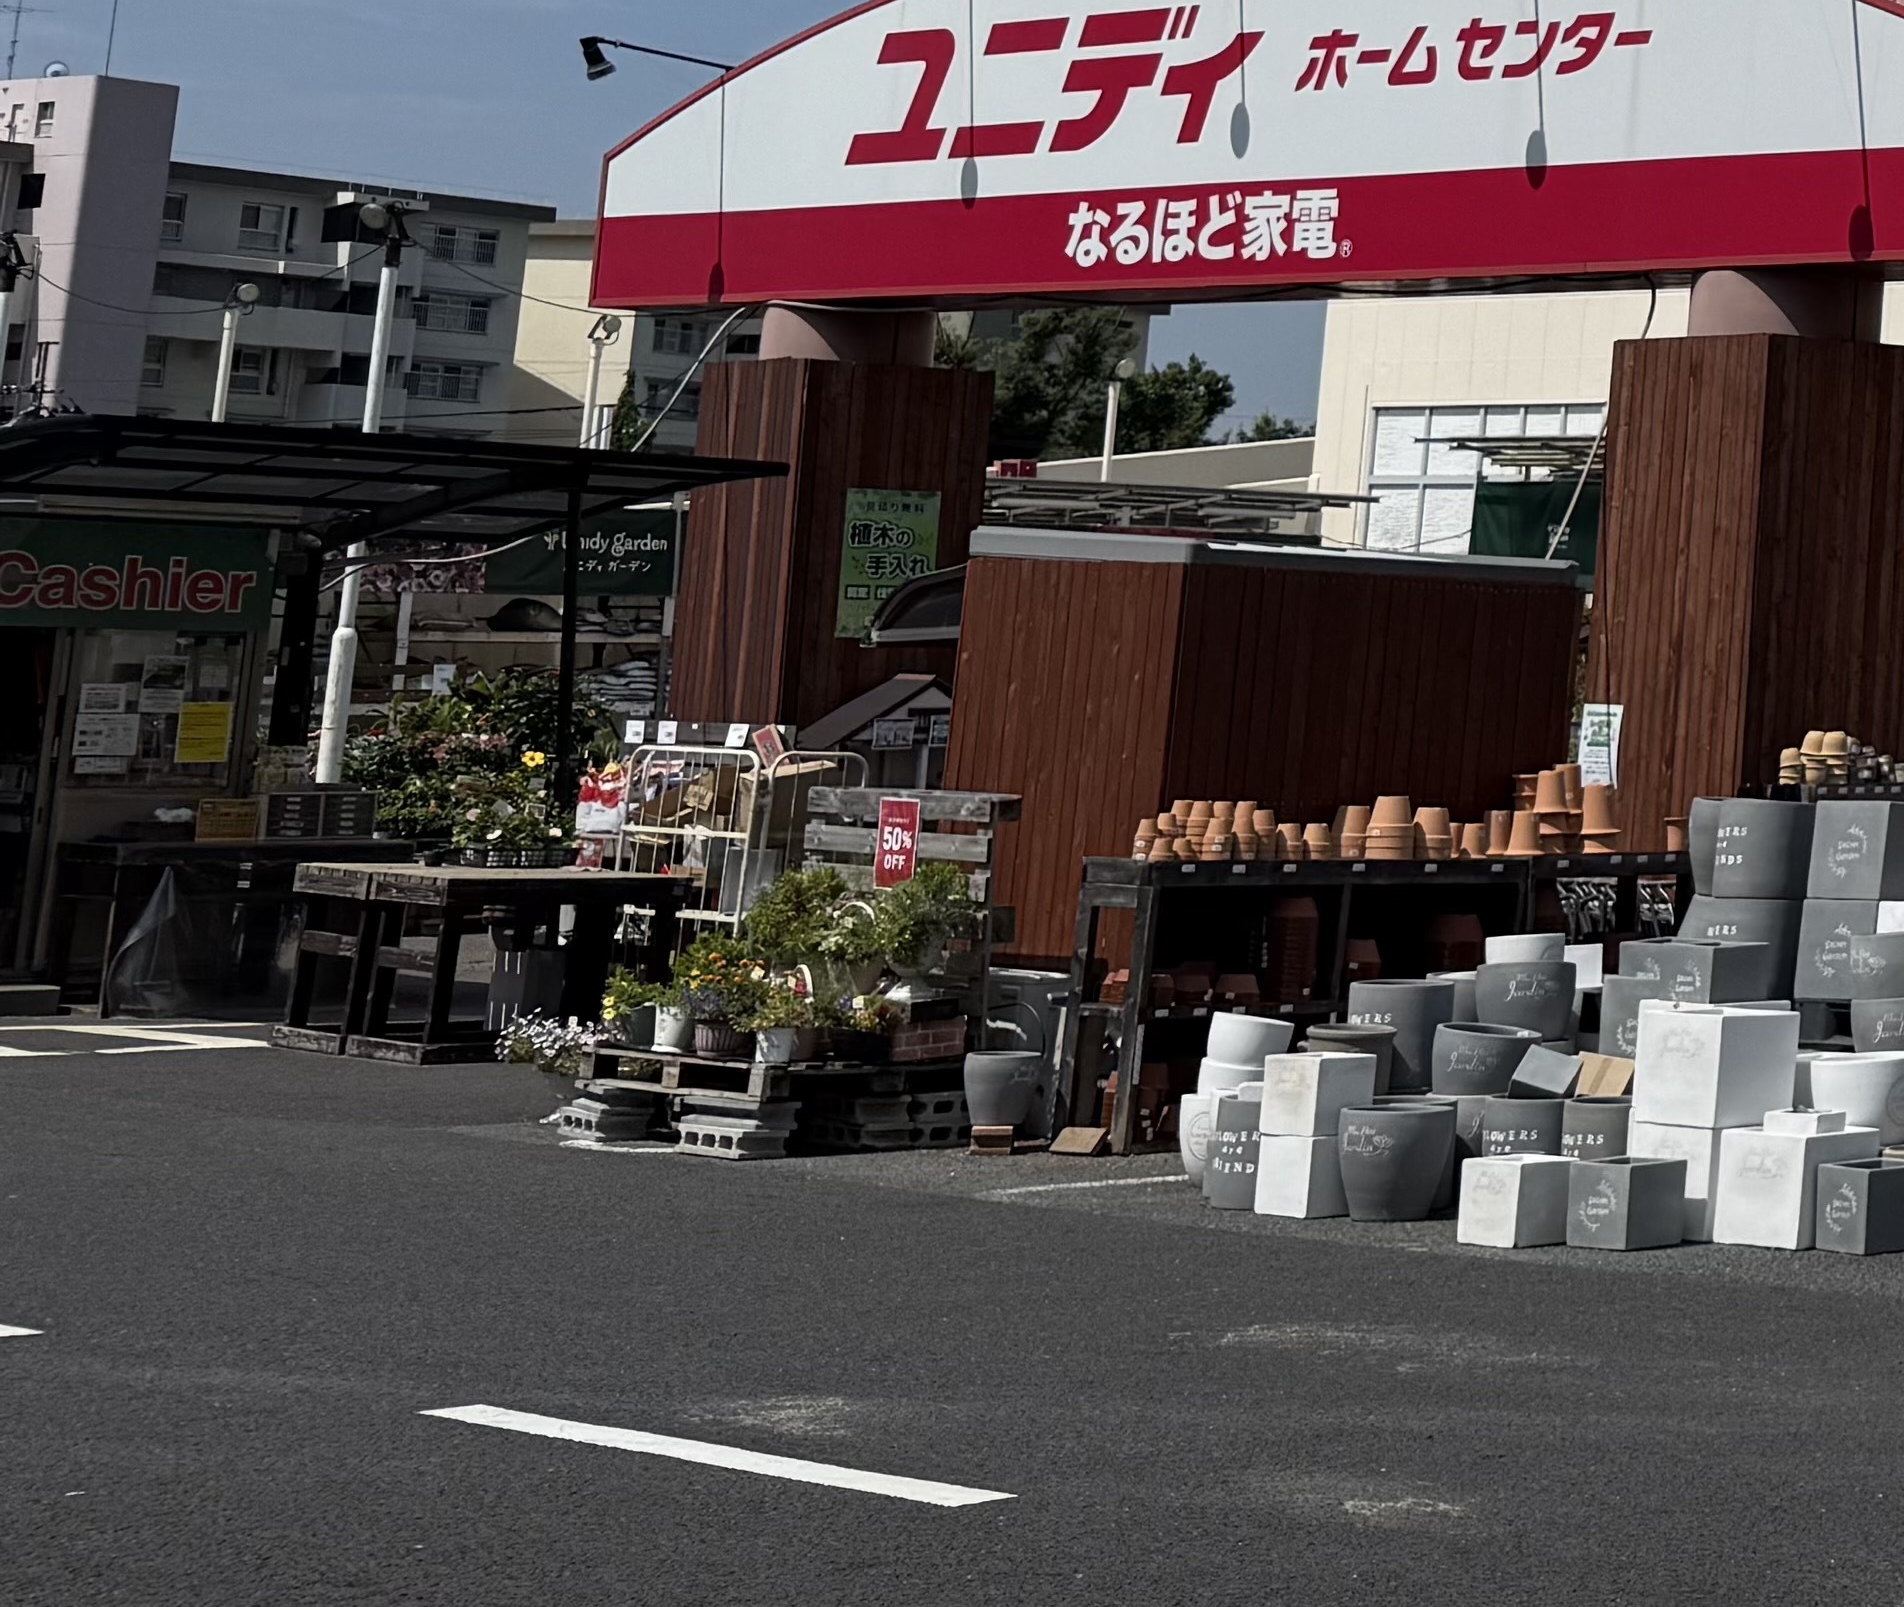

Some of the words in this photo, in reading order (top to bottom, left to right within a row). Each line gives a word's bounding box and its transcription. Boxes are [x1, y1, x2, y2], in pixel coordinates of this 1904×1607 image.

[844, 4, 1264, 166] ユニディ
[611, 531, 668, 557] garden
[849, 520, 914, 548] 植木の
[865, 553, 931, 580] 手入れ
[0, 550, 258, 613] Cashier
[882, 826, 913, 851] 50%
[883, 853, 906, 871] OFF
